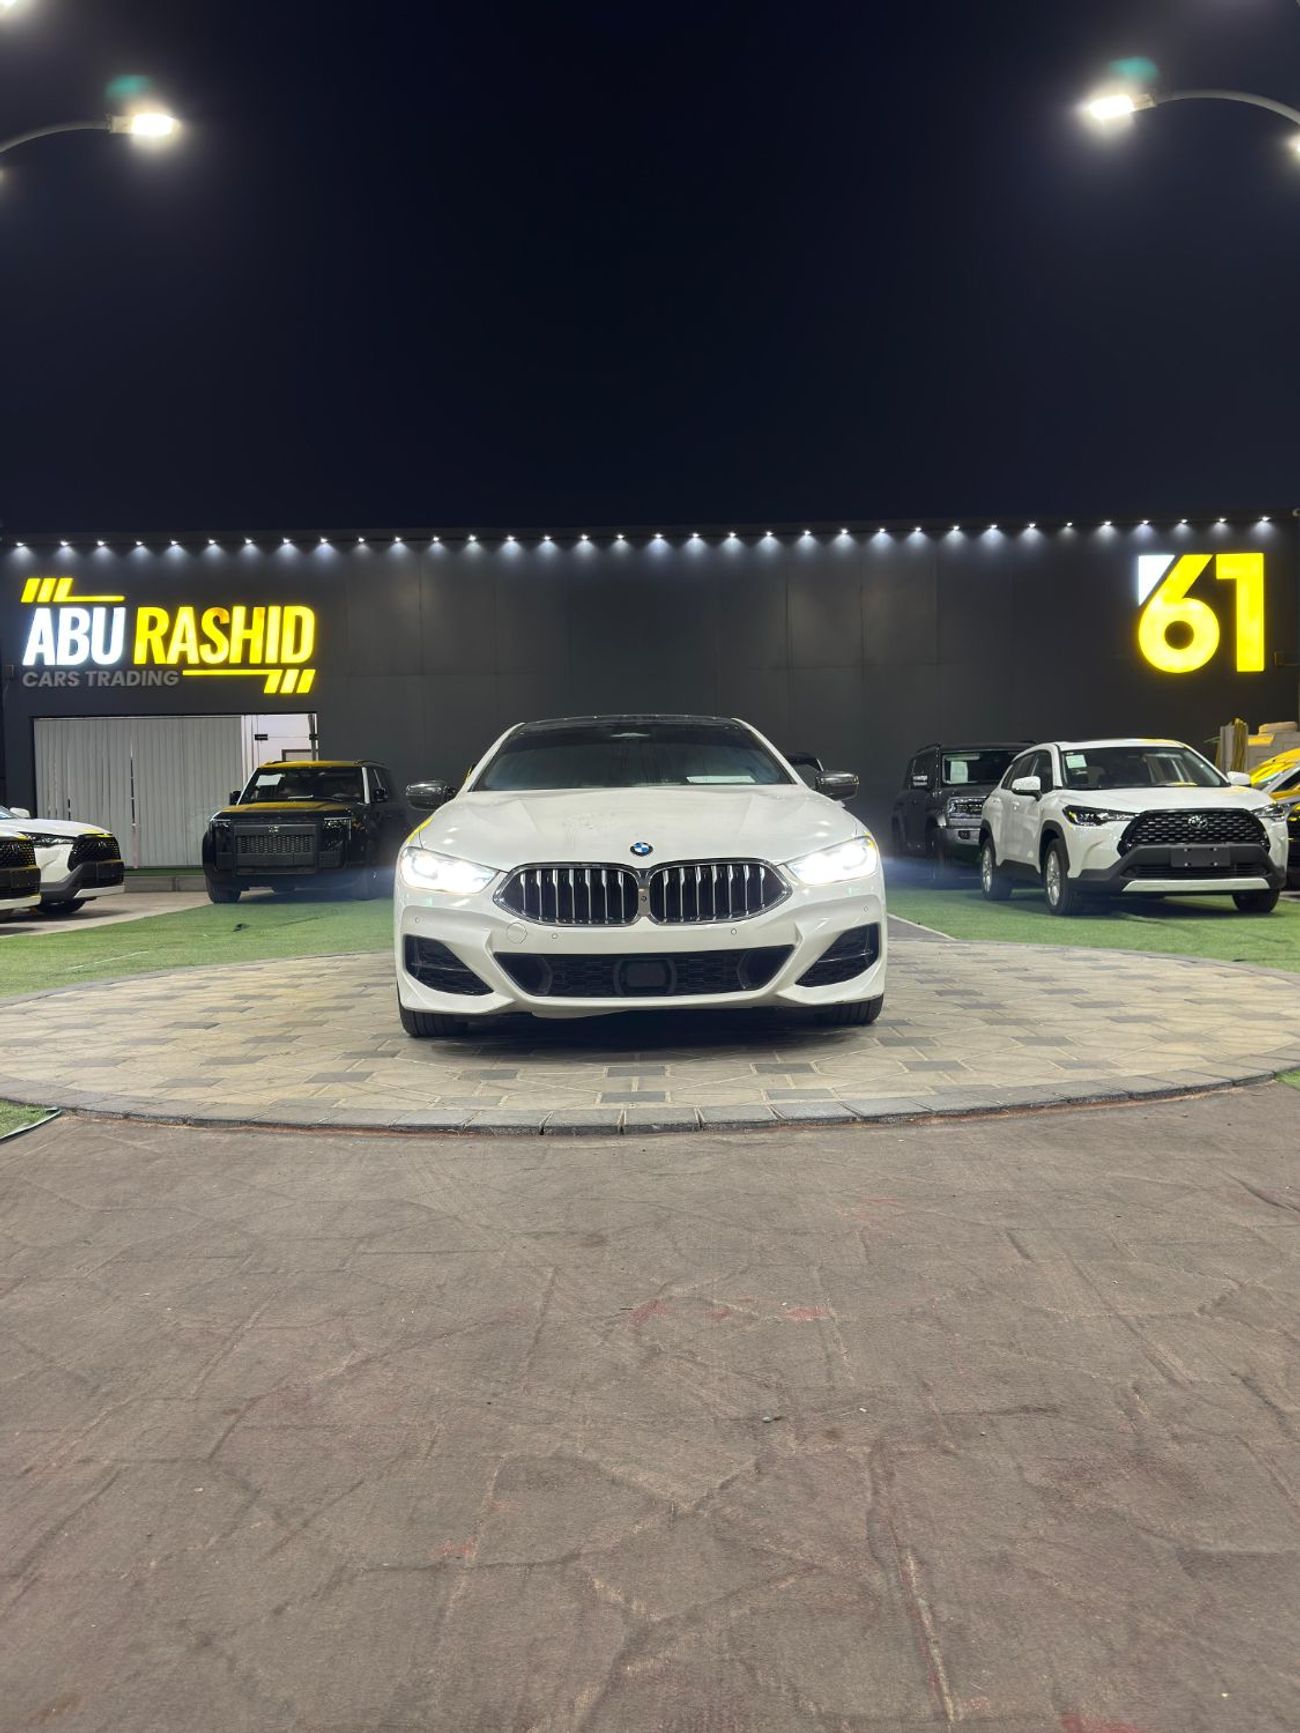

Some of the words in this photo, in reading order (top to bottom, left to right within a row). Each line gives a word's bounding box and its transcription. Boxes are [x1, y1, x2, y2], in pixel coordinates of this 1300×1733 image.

[22, 607, 126, 666] ABU
[133, 605, 315, 665] RASHID
[1138, 553, 1264, 673] 61
[22, 671, 80, 687] CARS
[85, 670, 179, 687] TRADING
